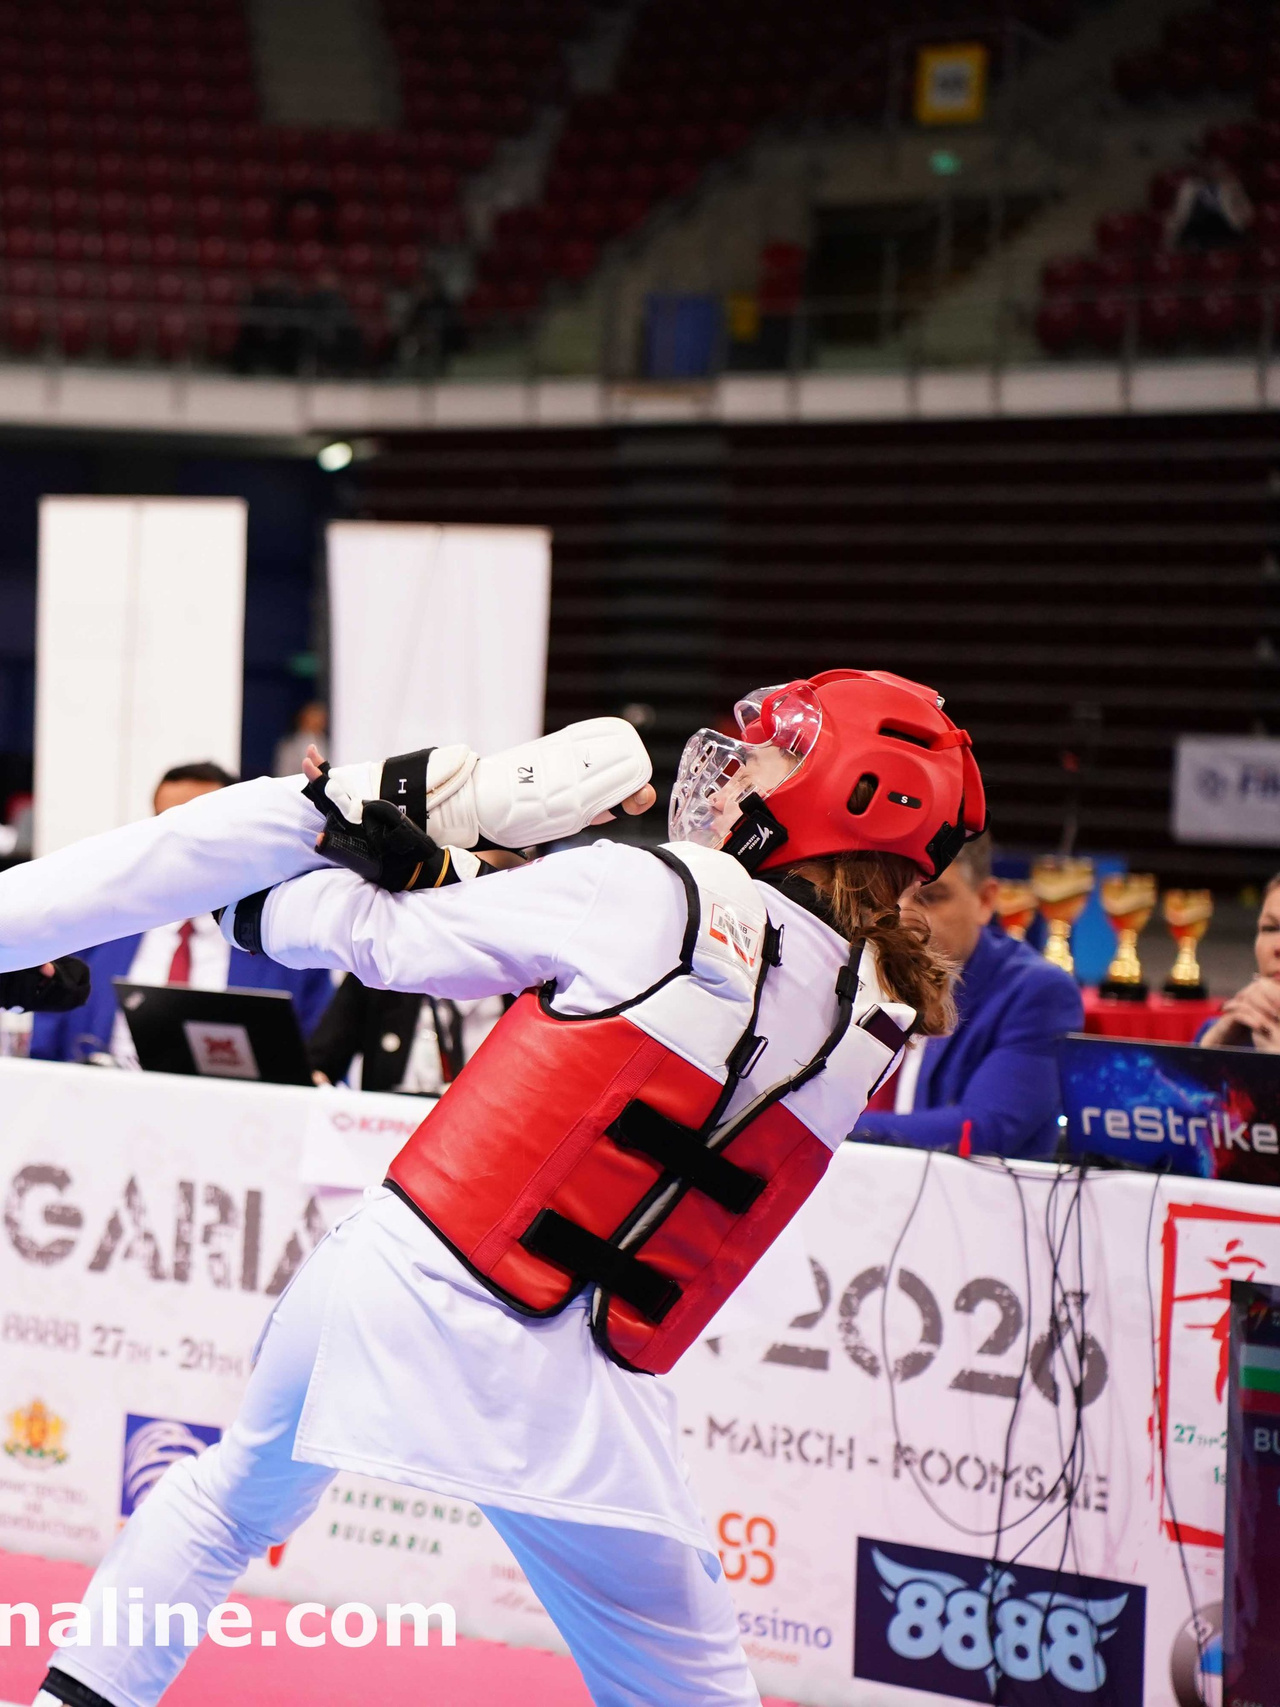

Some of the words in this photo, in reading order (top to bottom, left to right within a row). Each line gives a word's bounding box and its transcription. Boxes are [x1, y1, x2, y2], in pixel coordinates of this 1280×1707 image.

[517, 766, 535, 784] K2
[1081, 1105, 1279, 1154] reStrike
[705, 1414, 855, 1472] MARCH
[330, 1486, 483, 1528] TAEKWONDO
[328, 1521, 443, 1555] BULGARIA
[738, 1607, 832, 1649] ssimo
[887, 1578, 1107, 1693] 8888
